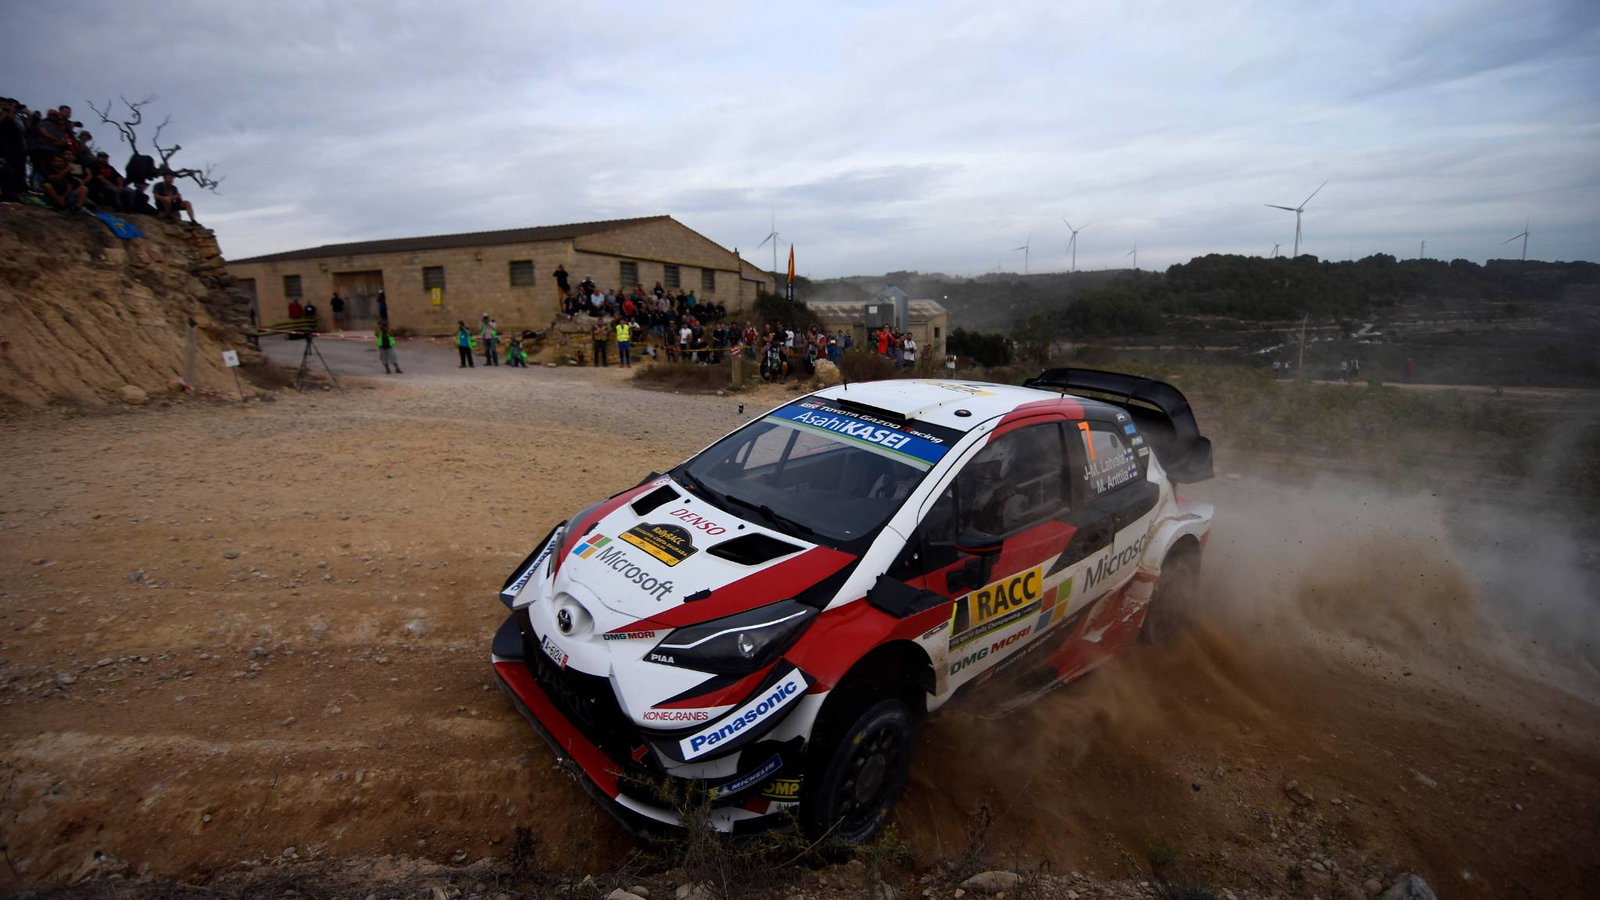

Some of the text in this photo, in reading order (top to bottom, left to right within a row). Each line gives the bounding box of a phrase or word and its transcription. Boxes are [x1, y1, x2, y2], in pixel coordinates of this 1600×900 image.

[793, 411, 911, 449] AsahiKASEI
[820, 405, 859, 418] TOYOTA
[859, 414, 902, 429] GAZOO
[901, 426, 944, 444] Racing
[1077, 421, 1096, 462] 7
[670, 508, 726, 535] DENSO
[595, 545, 674, 602] Microsoft
[977, 571, 1036, 622] RACC
[628, 631, 656, 639] MORI
[950, 646, 989, 675] DMG
[991, 625, 1032, 655] MORI
[651, 654, 675, 663] PIAA
[643, 711, 709, 721] KONECRANES
[690, 681, 797, 752] Panasonic
